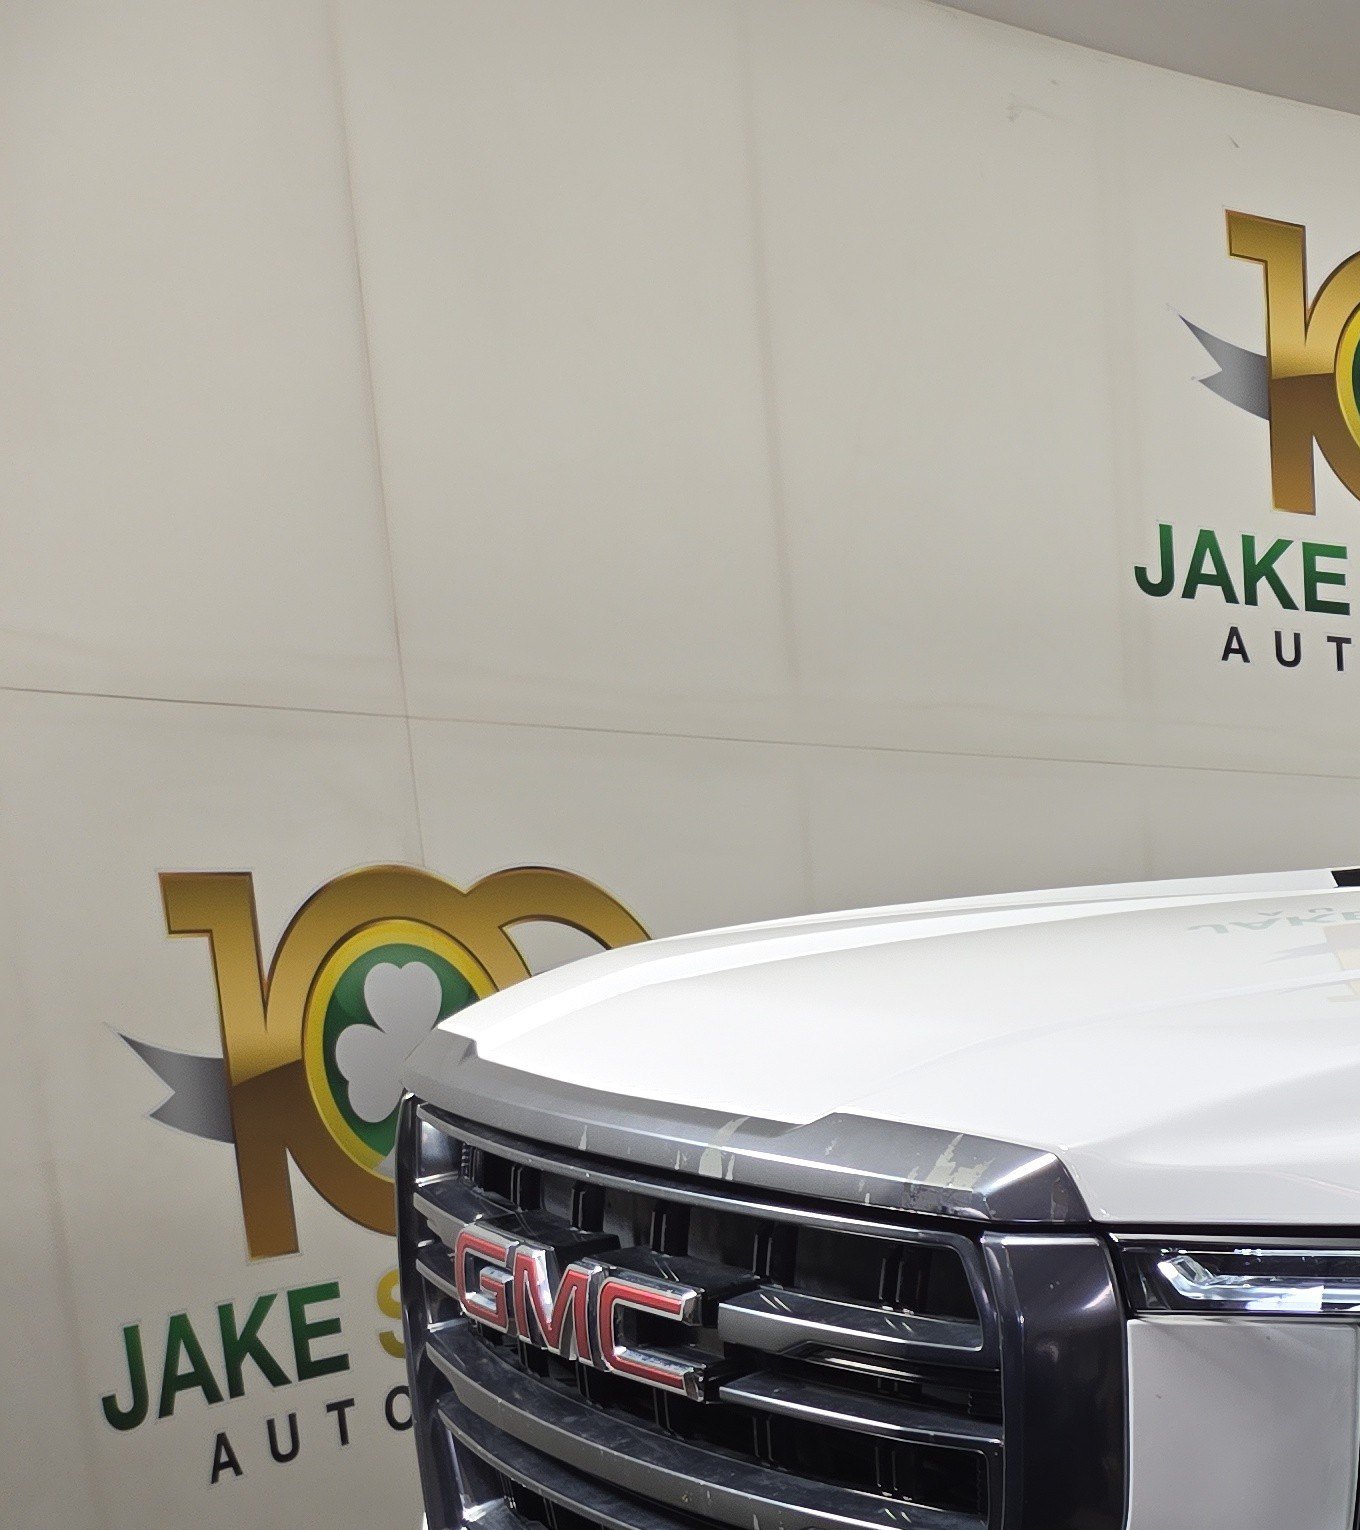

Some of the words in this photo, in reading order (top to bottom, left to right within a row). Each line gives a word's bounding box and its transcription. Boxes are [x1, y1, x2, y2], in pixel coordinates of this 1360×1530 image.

[1134, 523, 1350, 613] JAKE
[101, 1281, 351, 1432] JAKE
[453, 1220, 704, 1401] GMC
